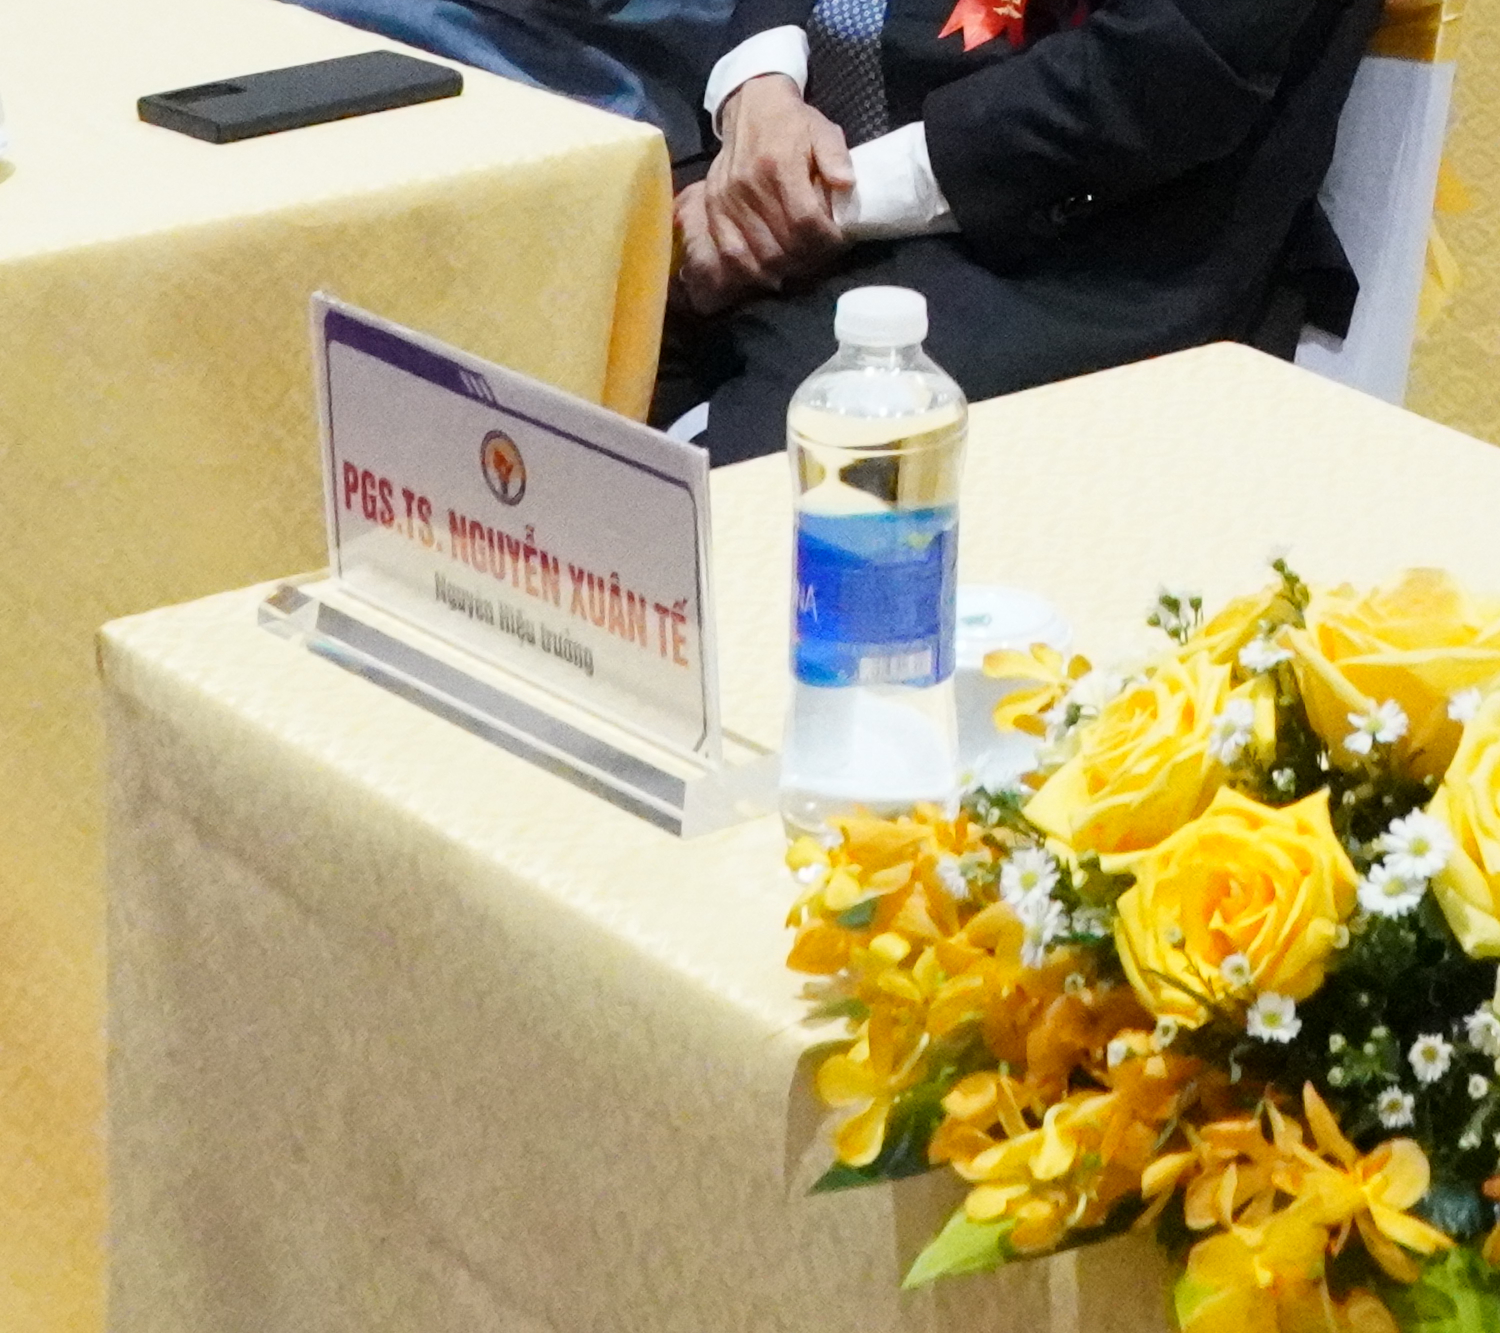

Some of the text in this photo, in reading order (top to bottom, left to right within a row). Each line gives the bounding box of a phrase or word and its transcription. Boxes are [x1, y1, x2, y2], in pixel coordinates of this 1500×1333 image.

[342, 459, 689, 668] PGS.TS. NGUYỄN XUÂN TẾ
